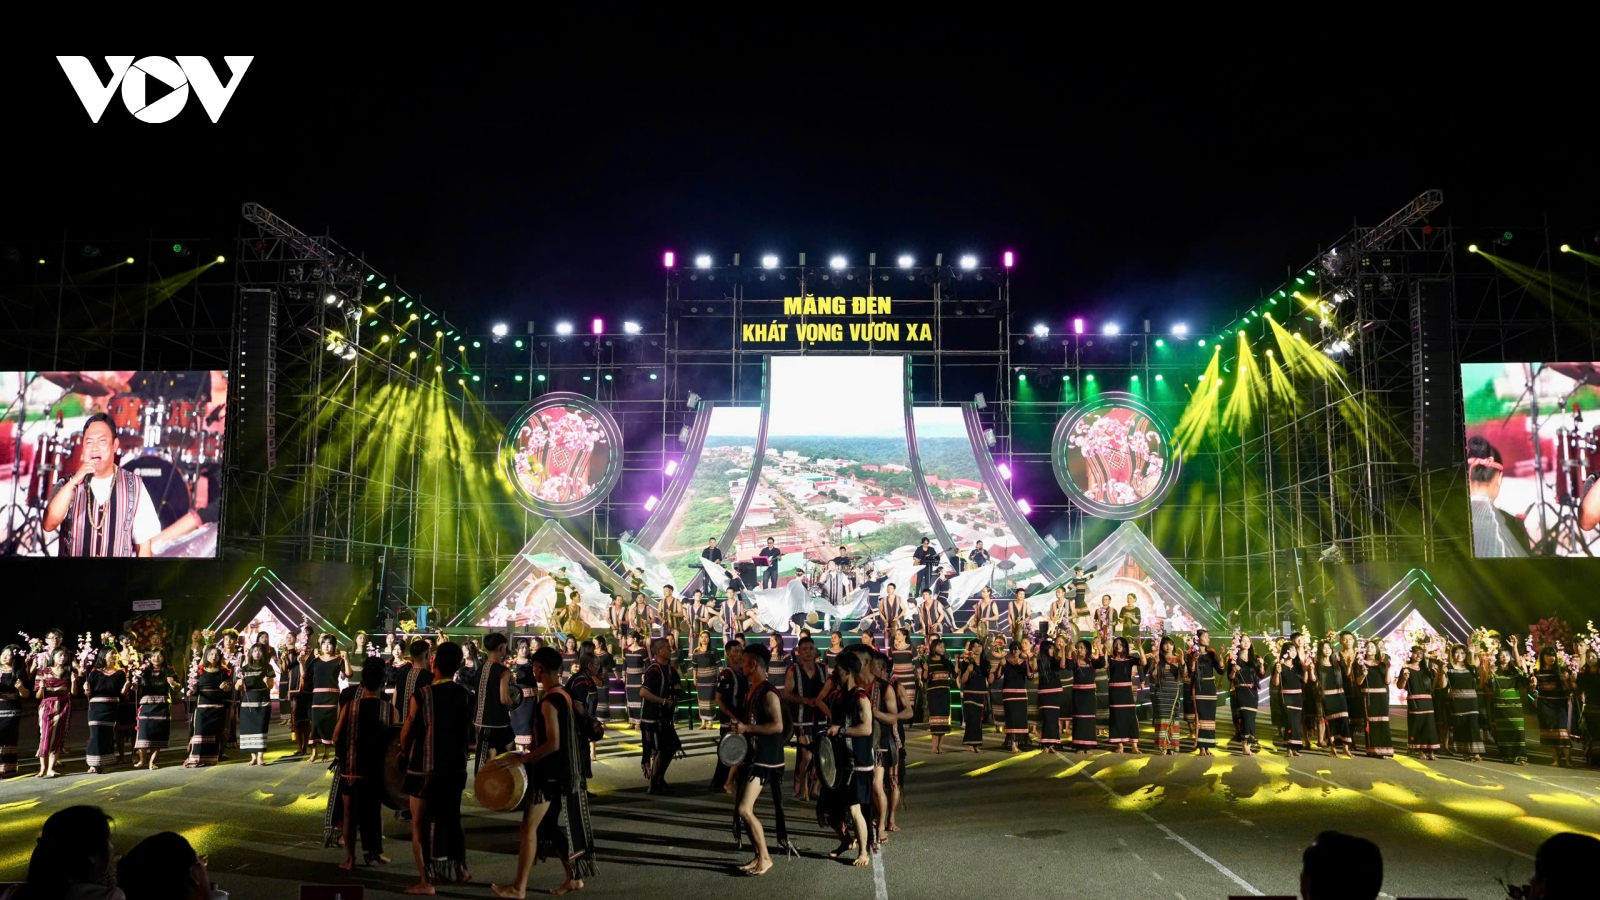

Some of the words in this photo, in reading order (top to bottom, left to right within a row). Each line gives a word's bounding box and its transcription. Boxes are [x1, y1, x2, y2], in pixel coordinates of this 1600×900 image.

[783, 293, 846, 315] MĂNG
[851, 296, 892, 315] ĐEN
[742, 320, 788, 342] KHÁT
[796, 323, 844, 346] VỌNG
[849, 321, 900, 342] VƯƠN
[906, 323, 932, 342] XA
